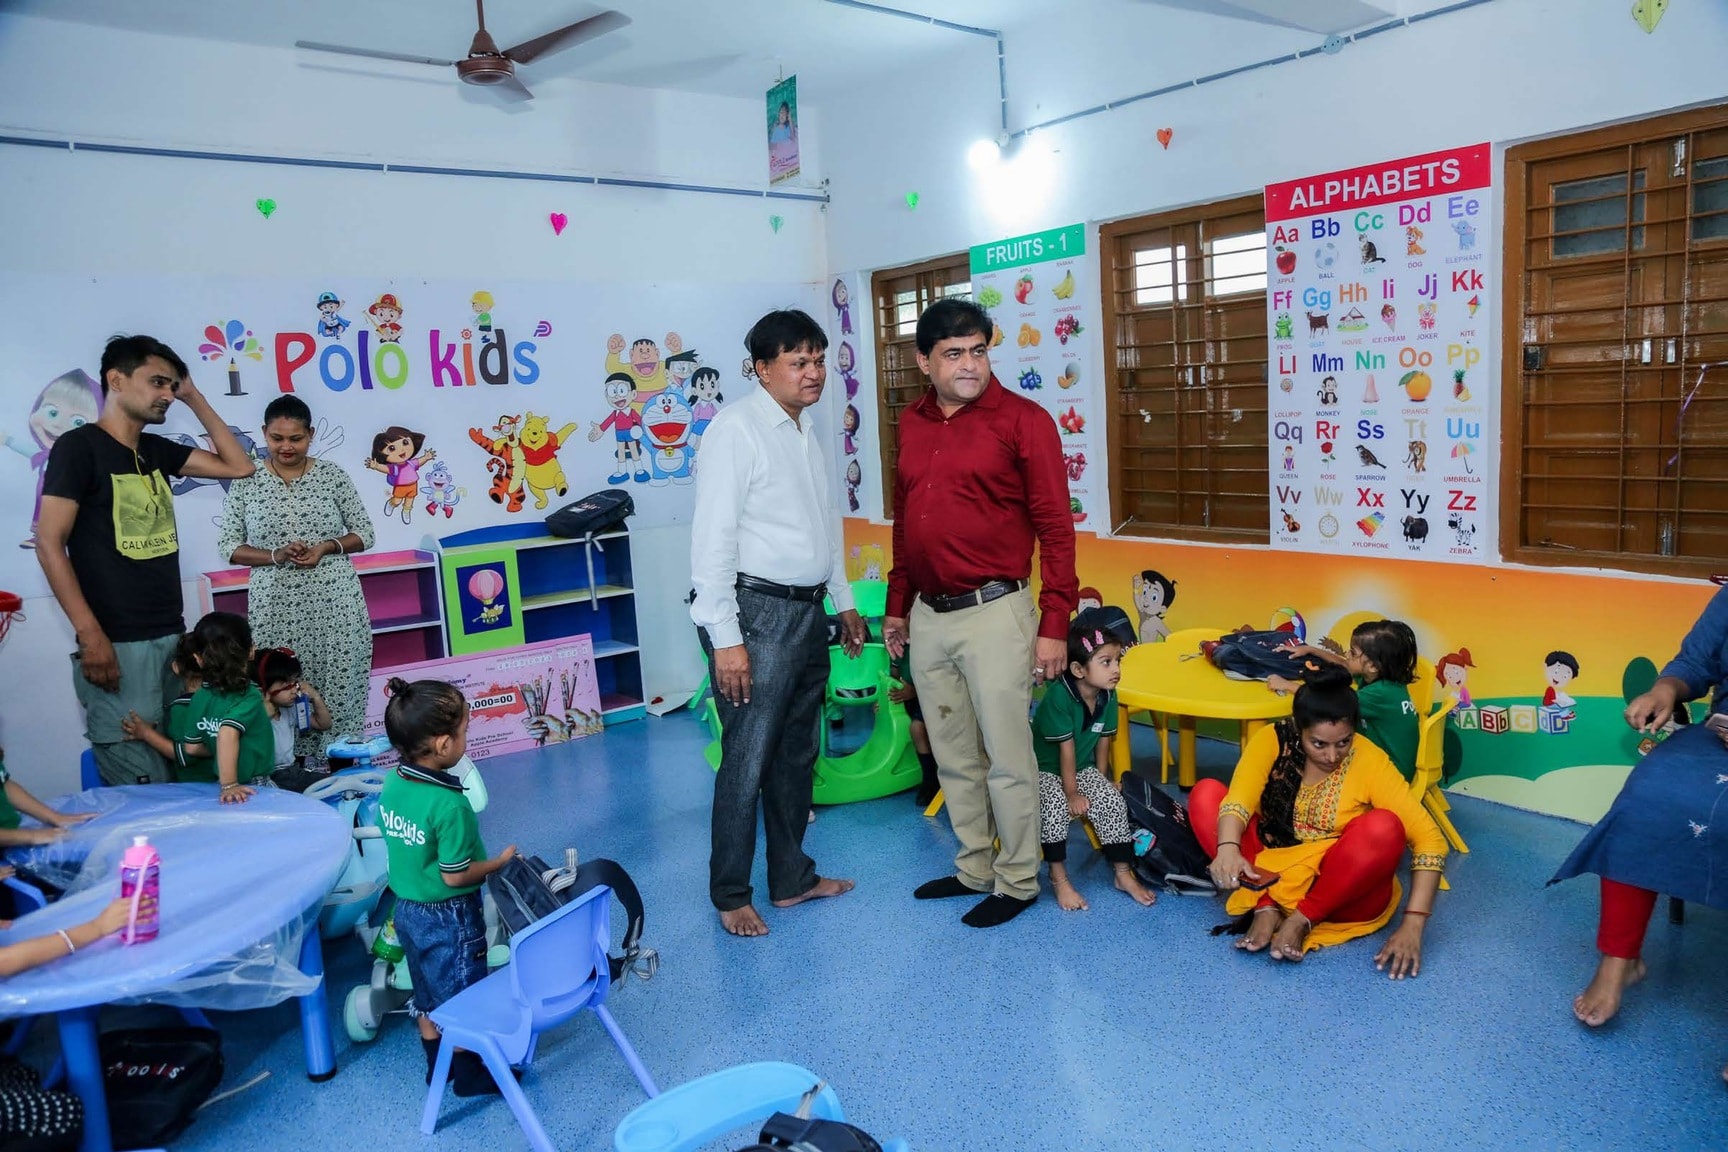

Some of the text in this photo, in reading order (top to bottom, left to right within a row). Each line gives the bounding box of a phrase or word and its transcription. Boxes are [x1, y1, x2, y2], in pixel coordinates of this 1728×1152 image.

[1289, 158, 1460, 210] ALPHABETS
[1398, 201, 1431, 226] Dd
[1448, 196, 1480, 218] Ee
[1312, 217, 1340, 239] Bb
[1354, 212, 1384, 232] Cc
[1272, 226, 1299, 245] Aa
[986, 238, 1044, 266] FRUITS
[1059, 232, 1066, 252] 1
[1446, 254, 1482, 264] ELEPHANT
[1383, 279, 1394, 299] Ii
[1418, 274, 1437, 300] Jj
[1452, 269, 1484, 292] Kk
[1274, 290, 1292, 310] Ff
[1303, 288, 1331, 310] Gg
[1340, 282, 1368, 304] Hh
[274, 328, 540, 392] Polo kids
[1280, 356, 1296, 374] Ll
[1312, 353, 1344, 373] Mm
[1356, 350, 1386, 370] Nn
[1399, 347, 1432, 368] Oo
[1447, 344, 1480, 369] Pp
[1274, 422, 1302, 444] Qq
[1316, 420, 1340, 440] Rr
[1357, 420, 1385, 440] Ss
[1404, 418, 1427, 439] Tt
[1447, 418, 1480, 439] Uu
[1276, 485, 1302, 504] Vv
[1314, 486, 1344, 505] Ww
[1357, 488, 1385, 508] Xx
[1400, 489, 1430, 514] Yy
[1447, 490, 1476, 511] Zz
[1463, 709, 1476, 728] A
[1482, 714, 1494, 730] B
[1500, 715, 1507, 730] b
[1515, 714, 1530, 727] C
[1541, 713, 1548, 730] d
[1553, 715, 1566, 731] D
